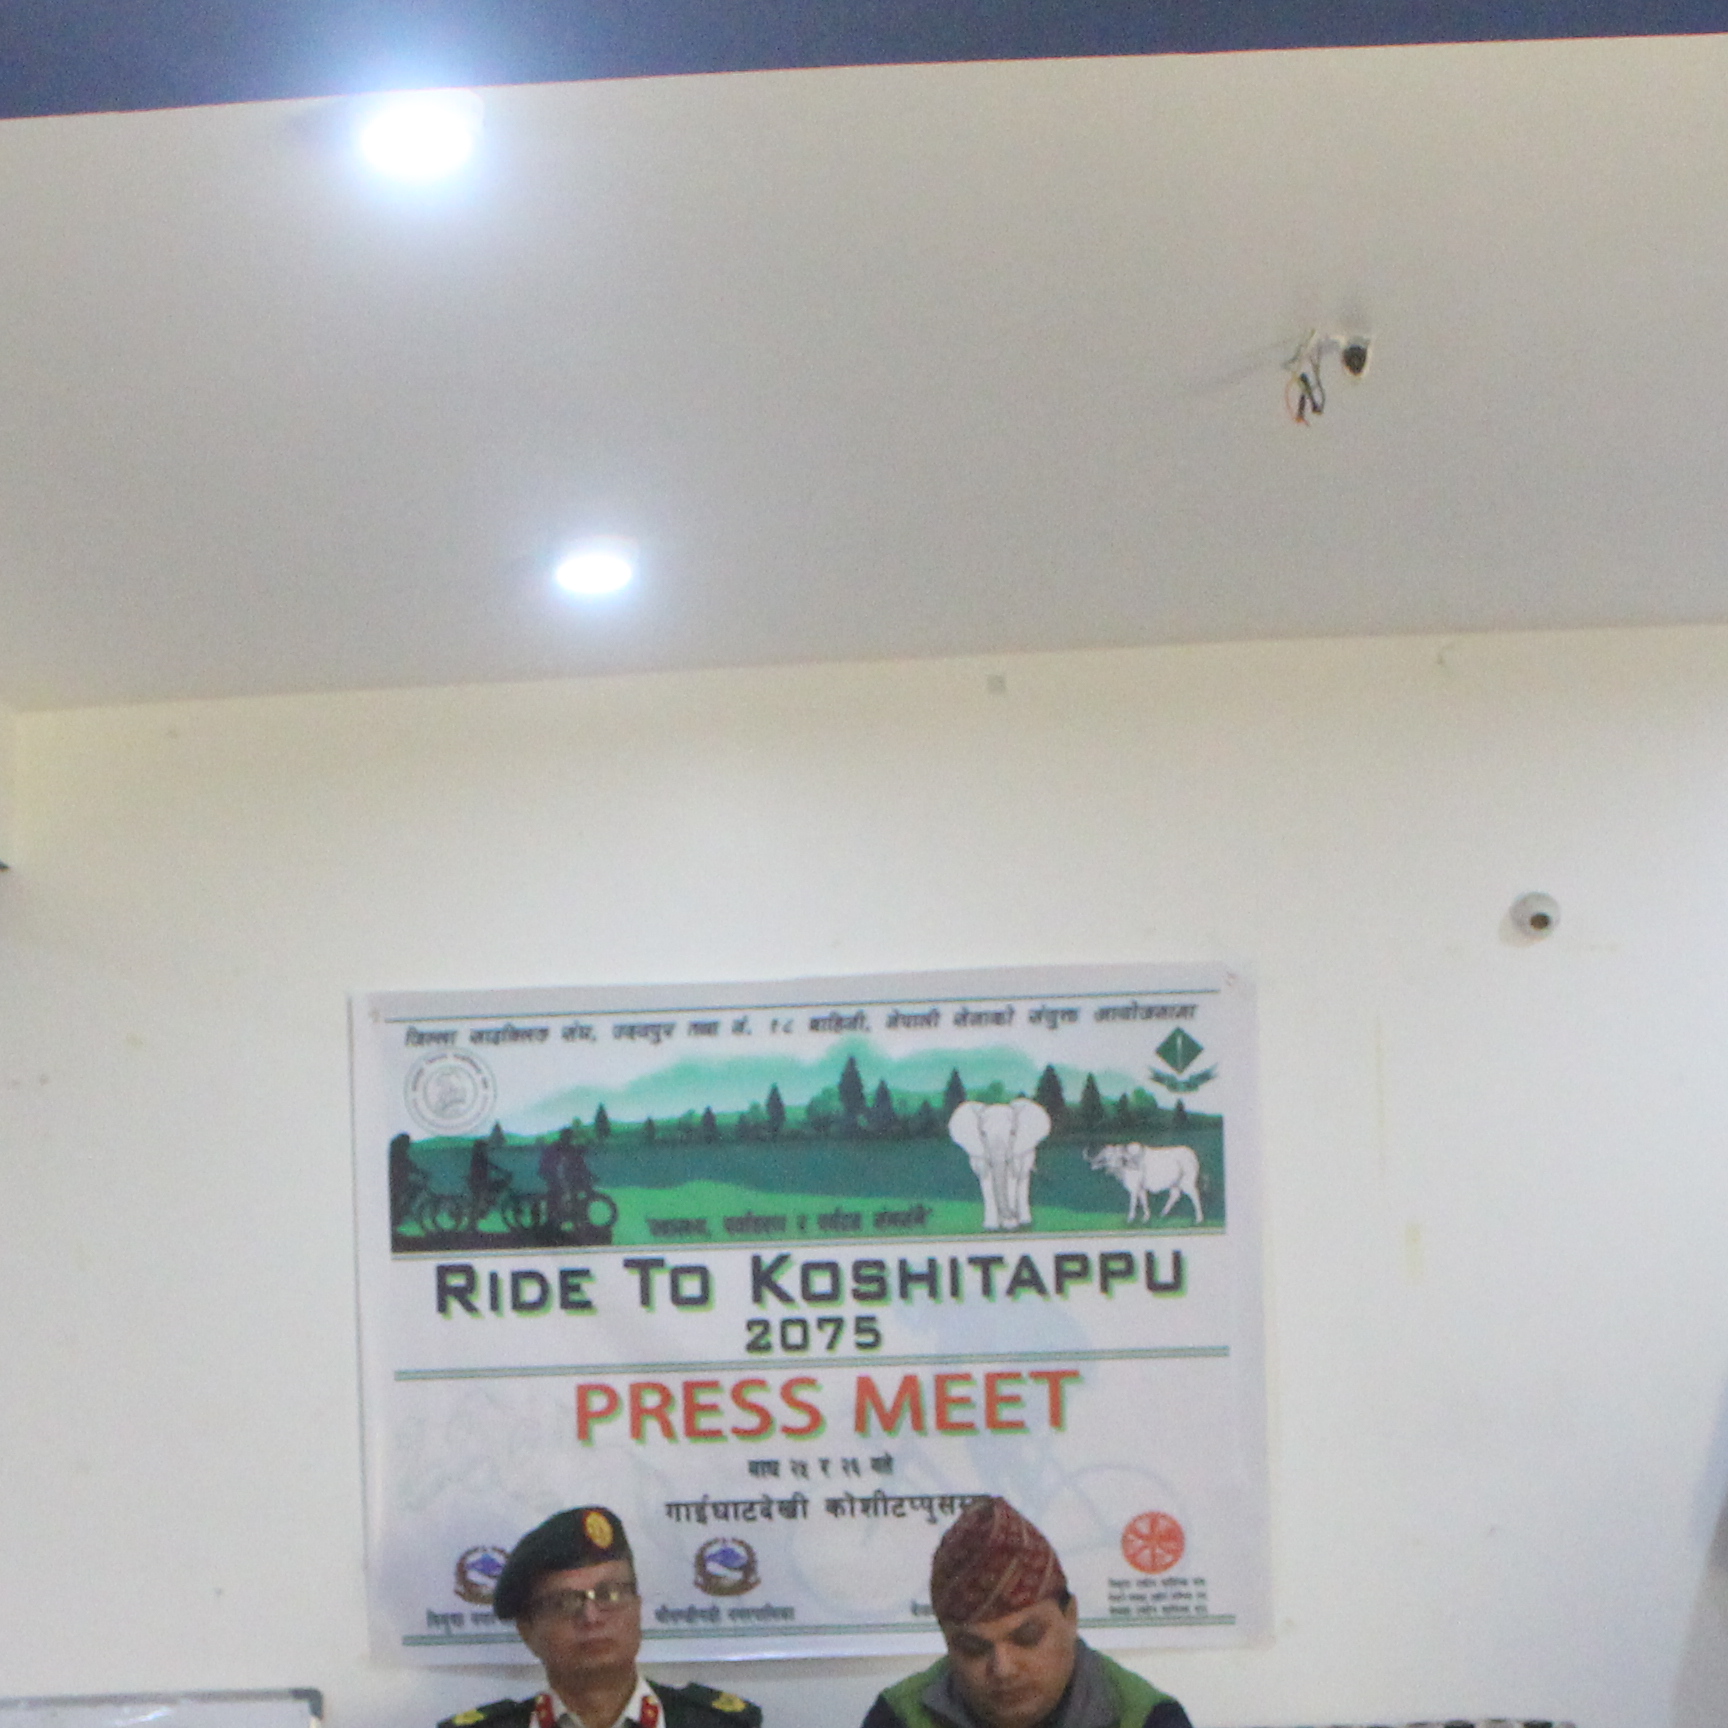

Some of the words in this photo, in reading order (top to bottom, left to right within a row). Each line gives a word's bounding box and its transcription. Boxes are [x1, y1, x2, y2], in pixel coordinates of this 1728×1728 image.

[744, 1314, 883, 1353] 2075
[575, 1374, 825, 1443] PRESS
[853, 1368, 1082, 1437] MEET
